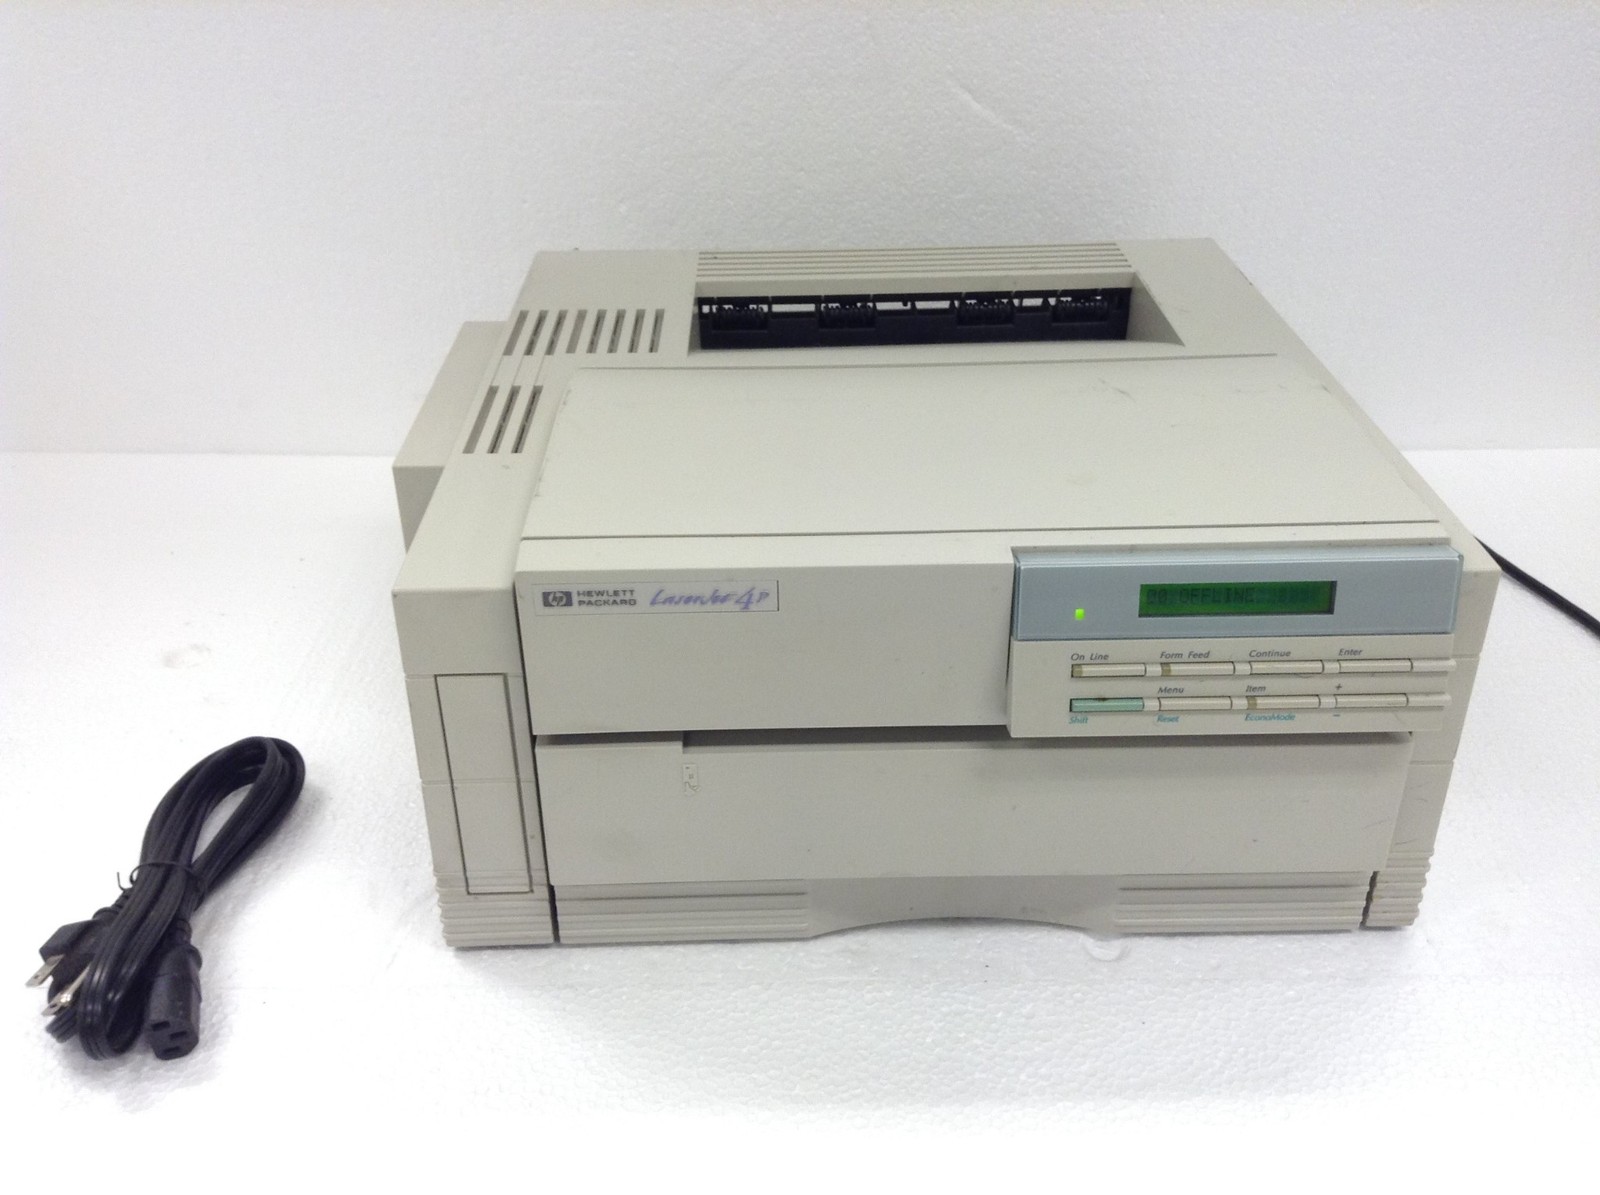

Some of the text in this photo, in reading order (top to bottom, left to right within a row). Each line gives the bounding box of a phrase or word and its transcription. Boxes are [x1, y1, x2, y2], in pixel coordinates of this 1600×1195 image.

[576, 589, 636, 598] HEWLETT
[577, 598, 637, 607] PACKARD
[1070, 652, 1110, 662] On Line
[1159, 650, 1211, 660] Form Feed
[1248, 649, 1292, 658] Continue
[1337, 648, 1363, 657] Enter
[1157, 686, 1185, 695] Menu
[1245, 684, 1267, 693] Item
[1068, 716, 1089, 725] Shift
[1156, 714, 1180, 724] Reset
